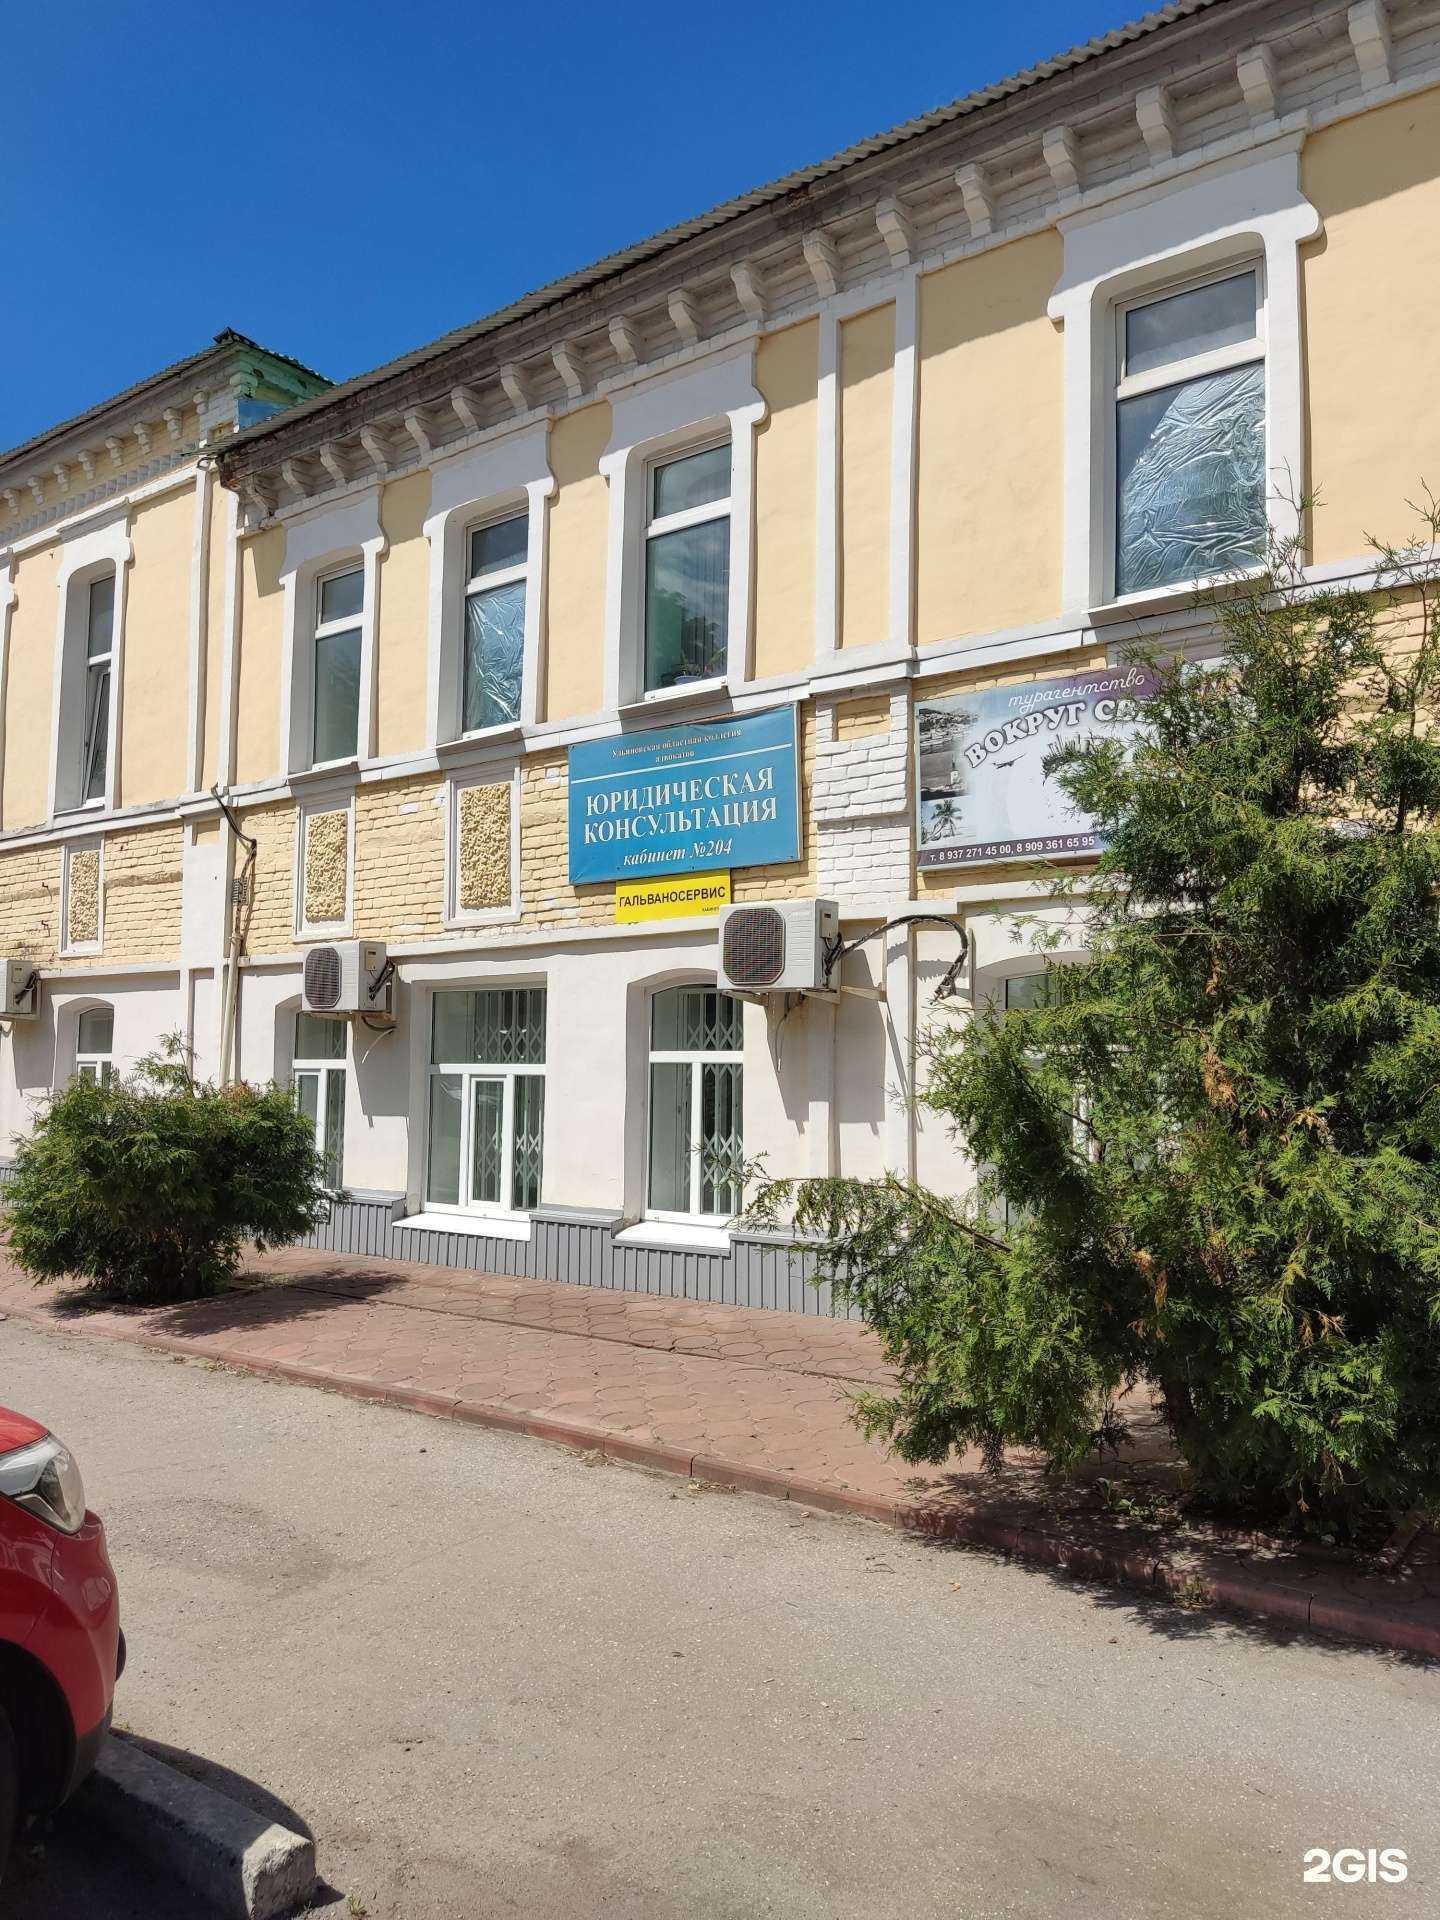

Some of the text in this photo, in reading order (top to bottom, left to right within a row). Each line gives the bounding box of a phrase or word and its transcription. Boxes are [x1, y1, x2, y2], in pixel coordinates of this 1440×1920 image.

[1008, 667, 1145, 714] турагентство
[963, 700, 1087, 769] ВОКРУГ
[586, 767, 774, 817] ЮРИДИЧЕСКАЯ
[584, 796, 777, 845] КОНСУЛЬТАЦИЯ
[623, 837, 734, 867] кабинет №204
[939, 852, 945, 861] 8
[947, 849, 964, 860] 937
[966, 847, 982, 859] 271
[985, 845, 997, 856] 45
[1016, 842, 1023, 853] 8
[1025, 840, 1043, 852] 909
[1045, 838, 1063, 850] 361
[1066, 836, 1079, 848] 65
[1081, 835, 1095, 847] 95
[619, 886, 726, 908] ГАЛЬВАНОСЕРВИС
